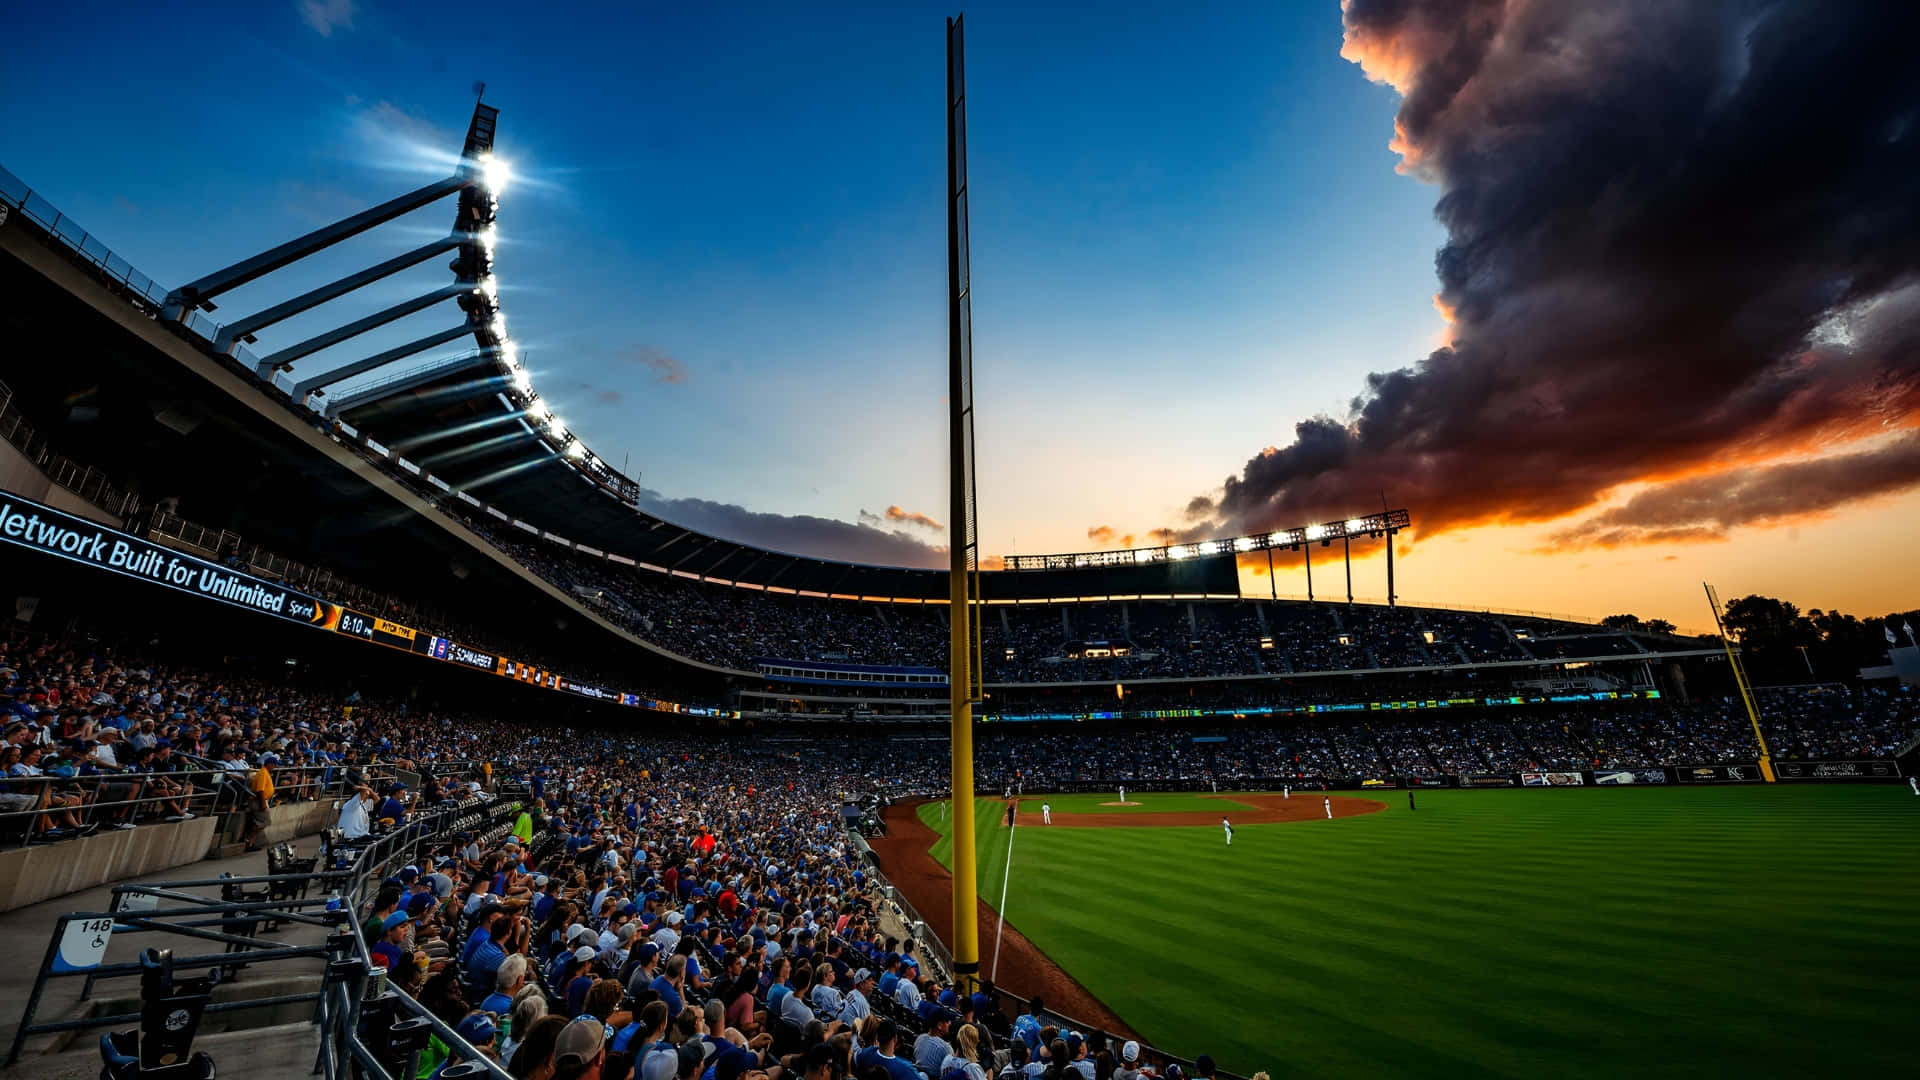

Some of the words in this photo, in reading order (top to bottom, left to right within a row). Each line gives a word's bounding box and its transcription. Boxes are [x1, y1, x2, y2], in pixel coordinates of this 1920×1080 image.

[109, 540, 165, 578] Built
[165, 558, 198, 587] for
[199, 568, 286, 613] Unlimited
[288, 600, 313, 618] Sprint
[342, 615, 363, 634] 8:10
[382, 621, 398, 633] PITCH
[399, 626, 411, 638] TYPE
[80, 919, 112, 933] 148
